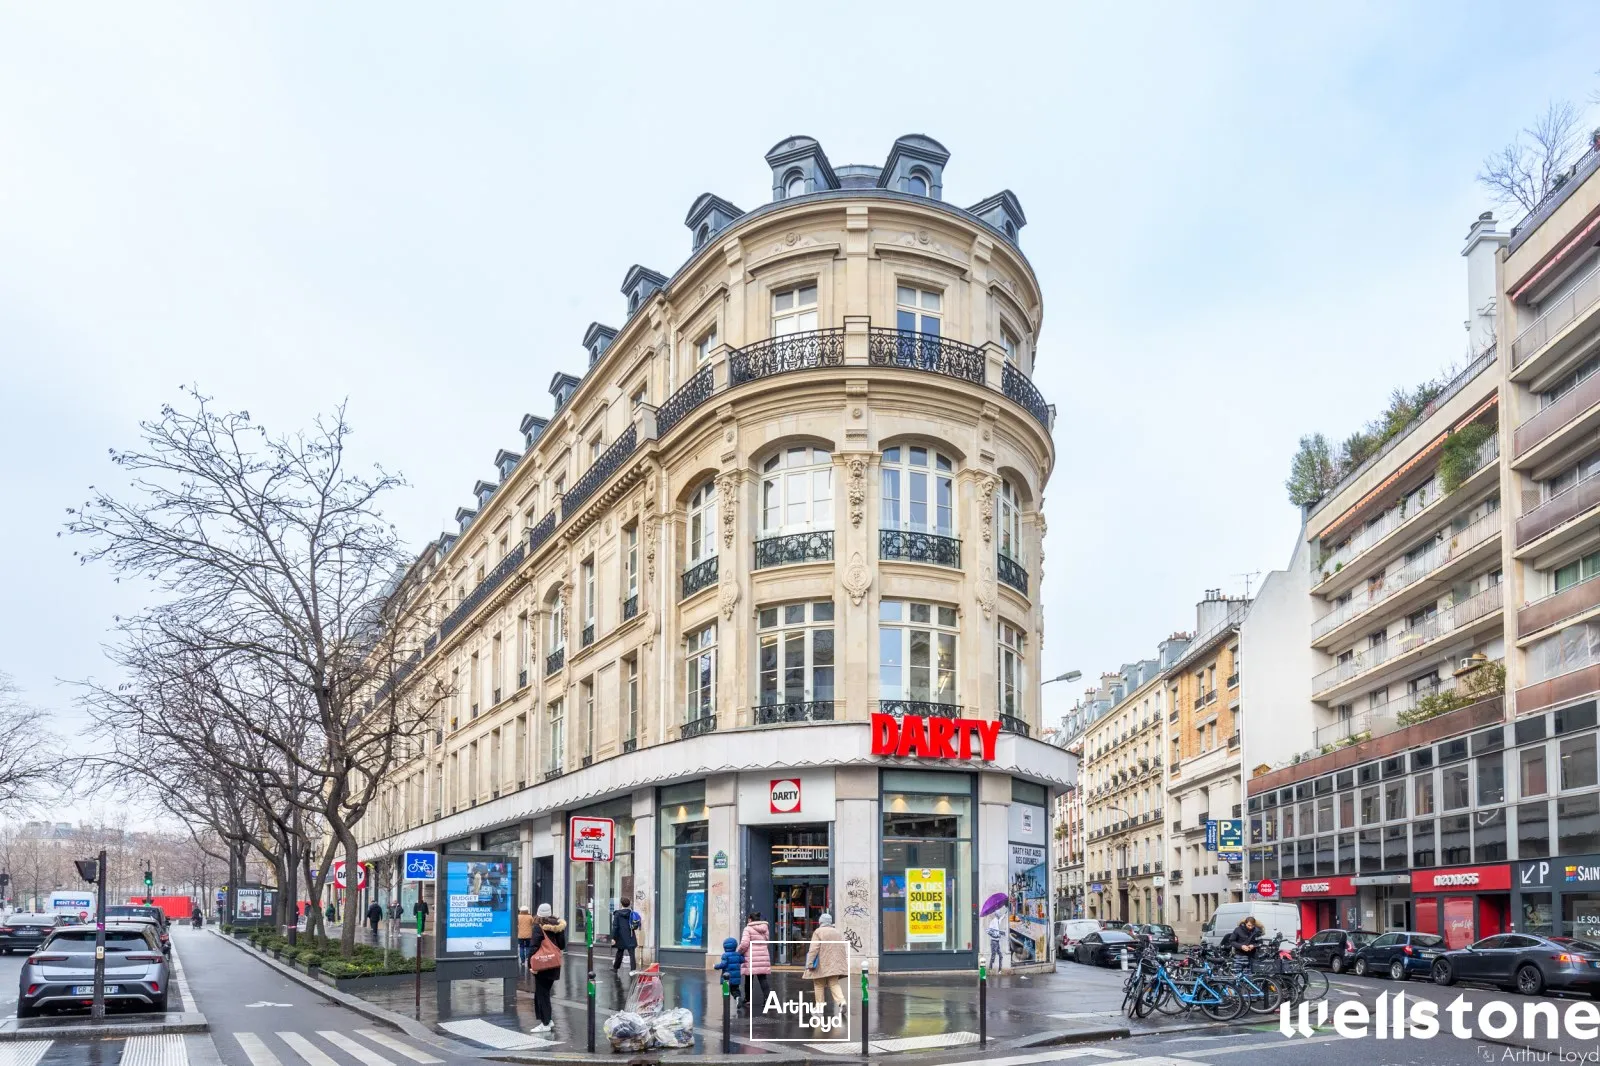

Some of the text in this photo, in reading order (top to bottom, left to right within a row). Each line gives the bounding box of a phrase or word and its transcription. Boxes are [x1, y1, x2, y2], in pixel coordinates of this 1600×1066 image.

[871, 712, 1003, 761] DARTY
[772, 791, 799, 801] DARTY
[1220, 821, 1232, 836] P
[1012, 846, 1024, 856] DARTY
[1024, 848, 1032, 856] FAIT
[1015, 856, 1023, 864] DES
[337, 871, 363, 879] DAY
[688, 871, 706, 879] CANAL+
[1539, 861, 1550, 884] P
[1577, 865, 1600, 881] SAIN
[1433, 872, 1480, 887] neoness
[911, 883, 943, 892] SLDES
[911, 892, 943, 902] SOLDES
[1577, 915, 1586, 924] LE
